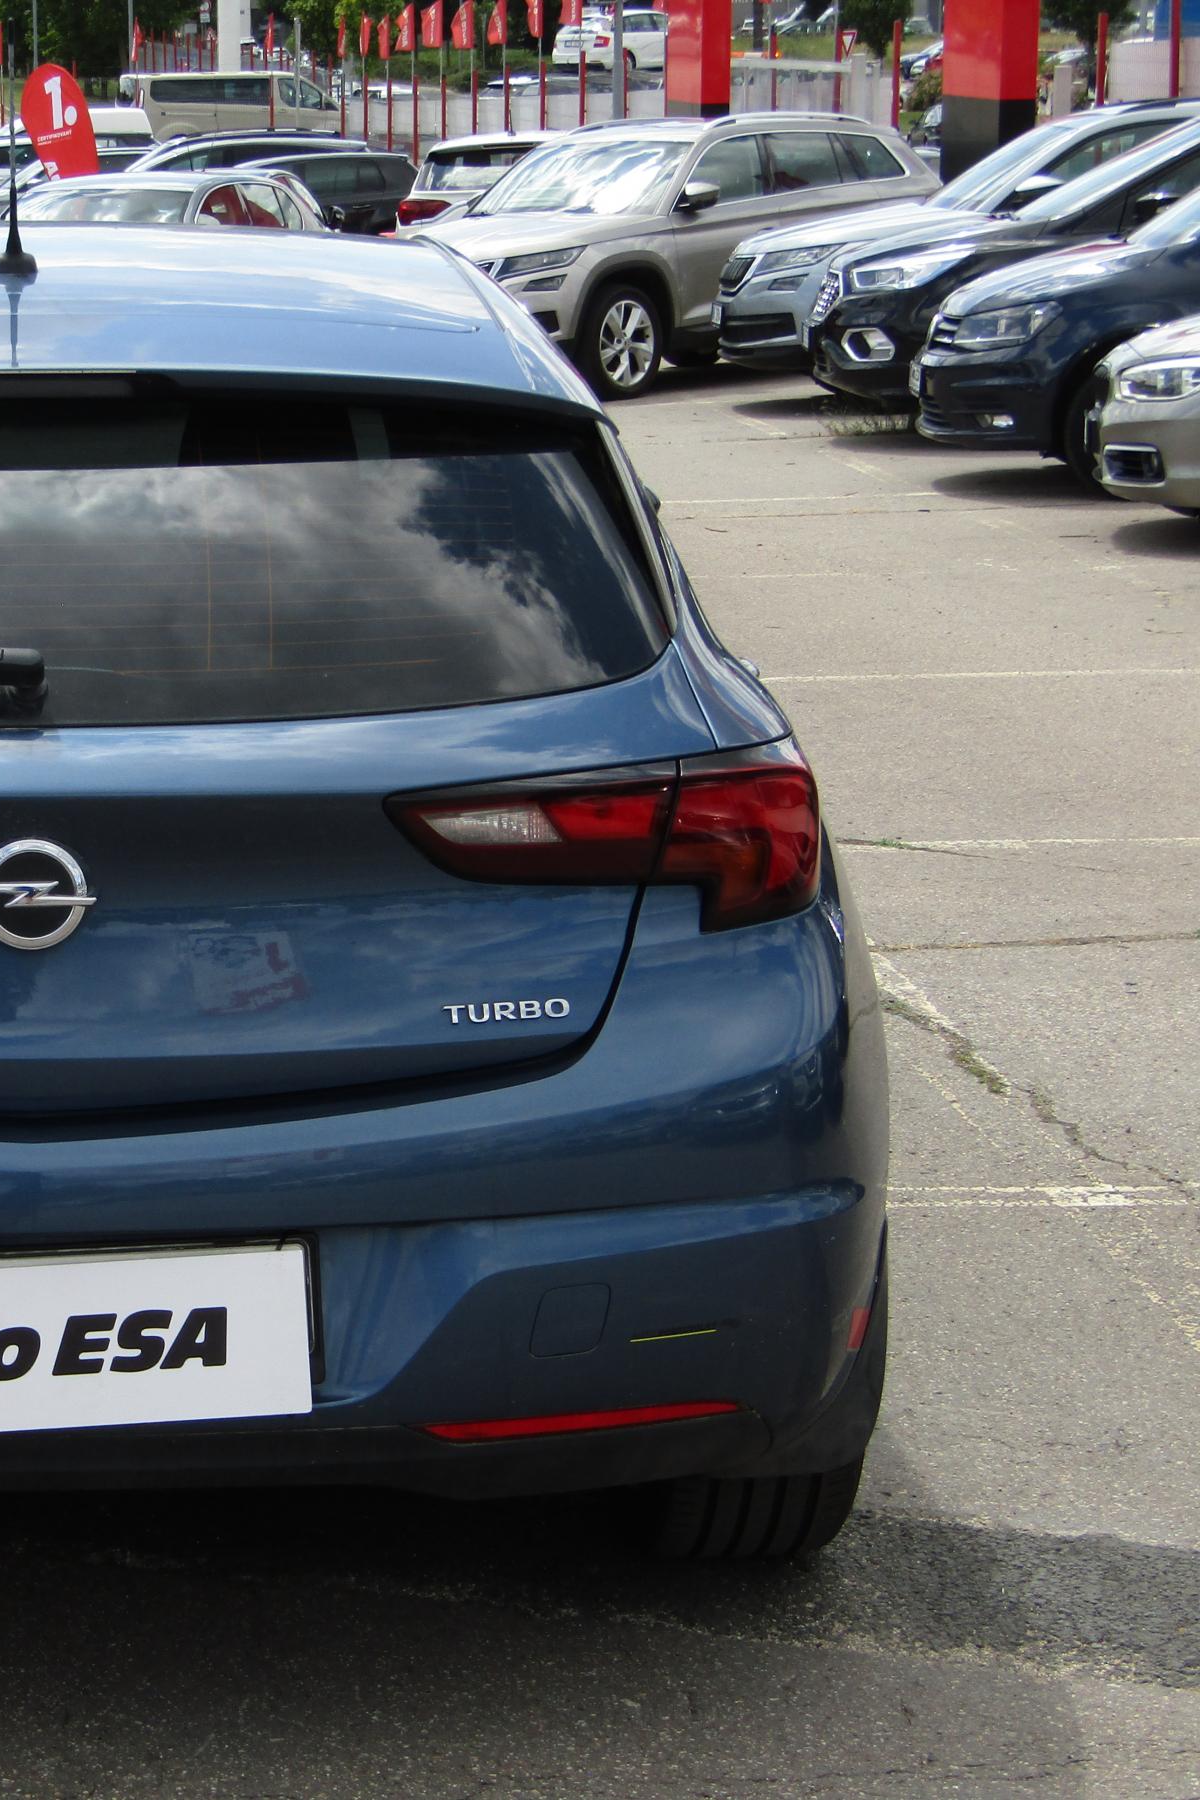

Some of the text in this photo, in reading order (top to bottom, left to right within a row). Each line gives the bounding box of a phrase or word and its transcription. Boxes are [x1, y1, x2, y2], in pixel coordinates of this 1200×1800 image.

[44, 76, 78, 130] 1.
[443, 998, 570, 1025] TURBO
[52, 1306, 228, 1376] ESA
